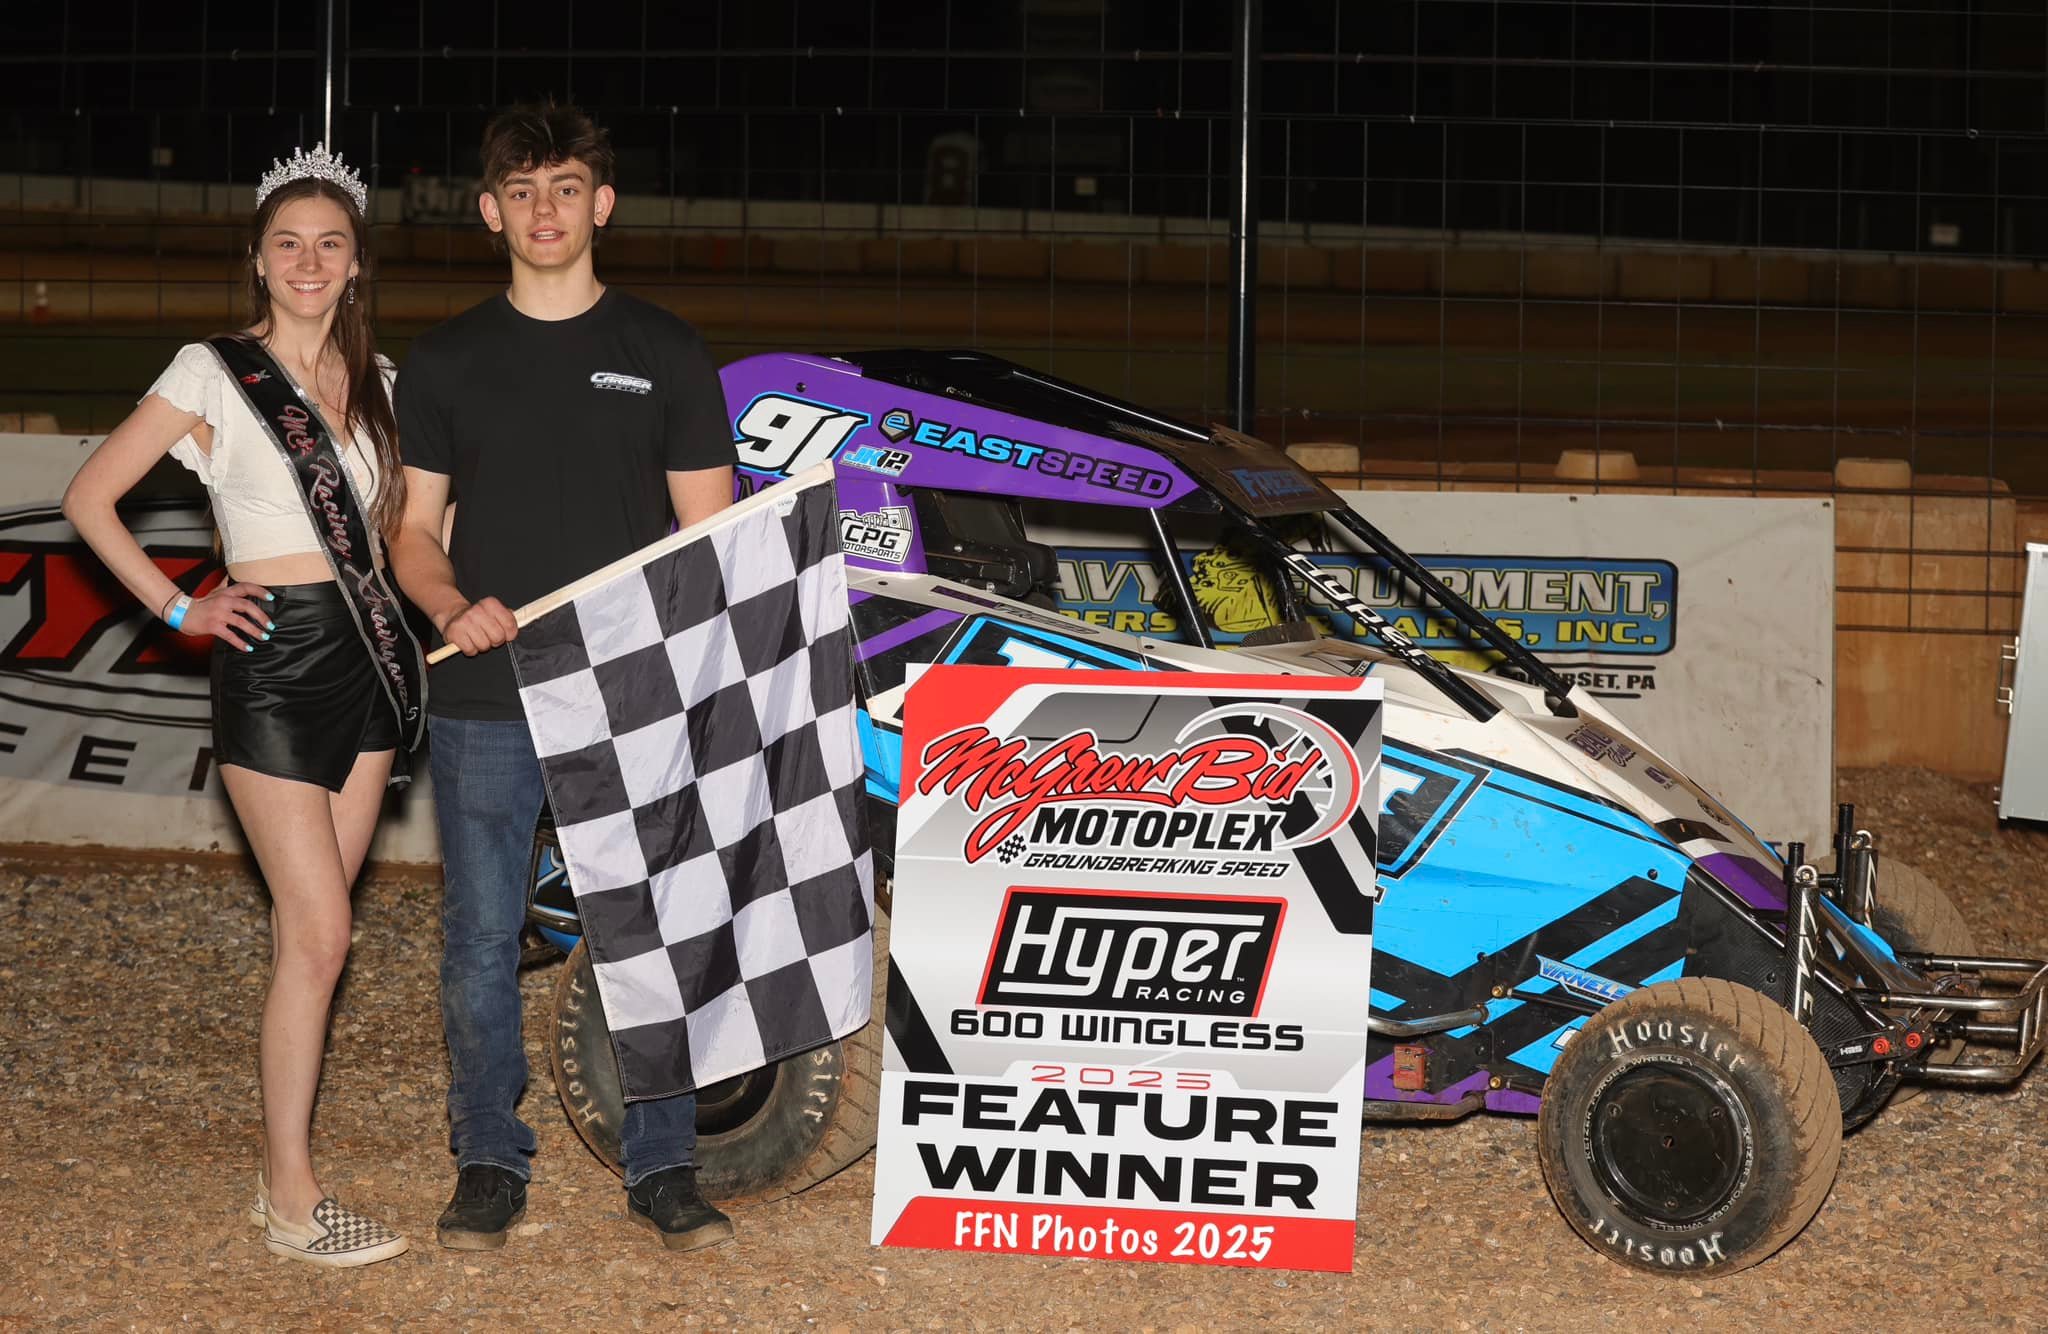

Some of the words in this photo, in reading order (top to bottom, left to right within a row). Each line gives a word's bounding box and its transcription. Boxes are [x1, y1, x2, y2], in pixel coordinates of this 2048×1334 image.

[735, 394, 868, 477] 91
[309, 455, 352, 559] Racing
[844, 524, 900, 549] CPG
[1053, 560, 1166, 603] AVY
[1291, 565, 1667, 619] QUIPMENT,
[1557, 621, 1656, 644] INC.
[1627, 674, 1656, 690] PA
[919, 727, 1178, 864] McGrew
[1174, 736, 1322, 804] Bid
[1030, 807, 1287, 851] MOTOPLEX
[1023, 852, 1214, 875] GROUNDBREAKING
[1218, 860, 1290, 878] SPEED
[998, 905, 1265, 998] Hyper
[1135, 986, 1246, 1004] RACING
[950, 1009, 1044, 1039] 600
[1061, 1015, 1305, 1052] WINGLESS
[1031, 1065, 1212, 1090] 2025
[901, 1080, 1340, 1148] FEATURE
[916, 1143, 1319, 1210] WINNER
